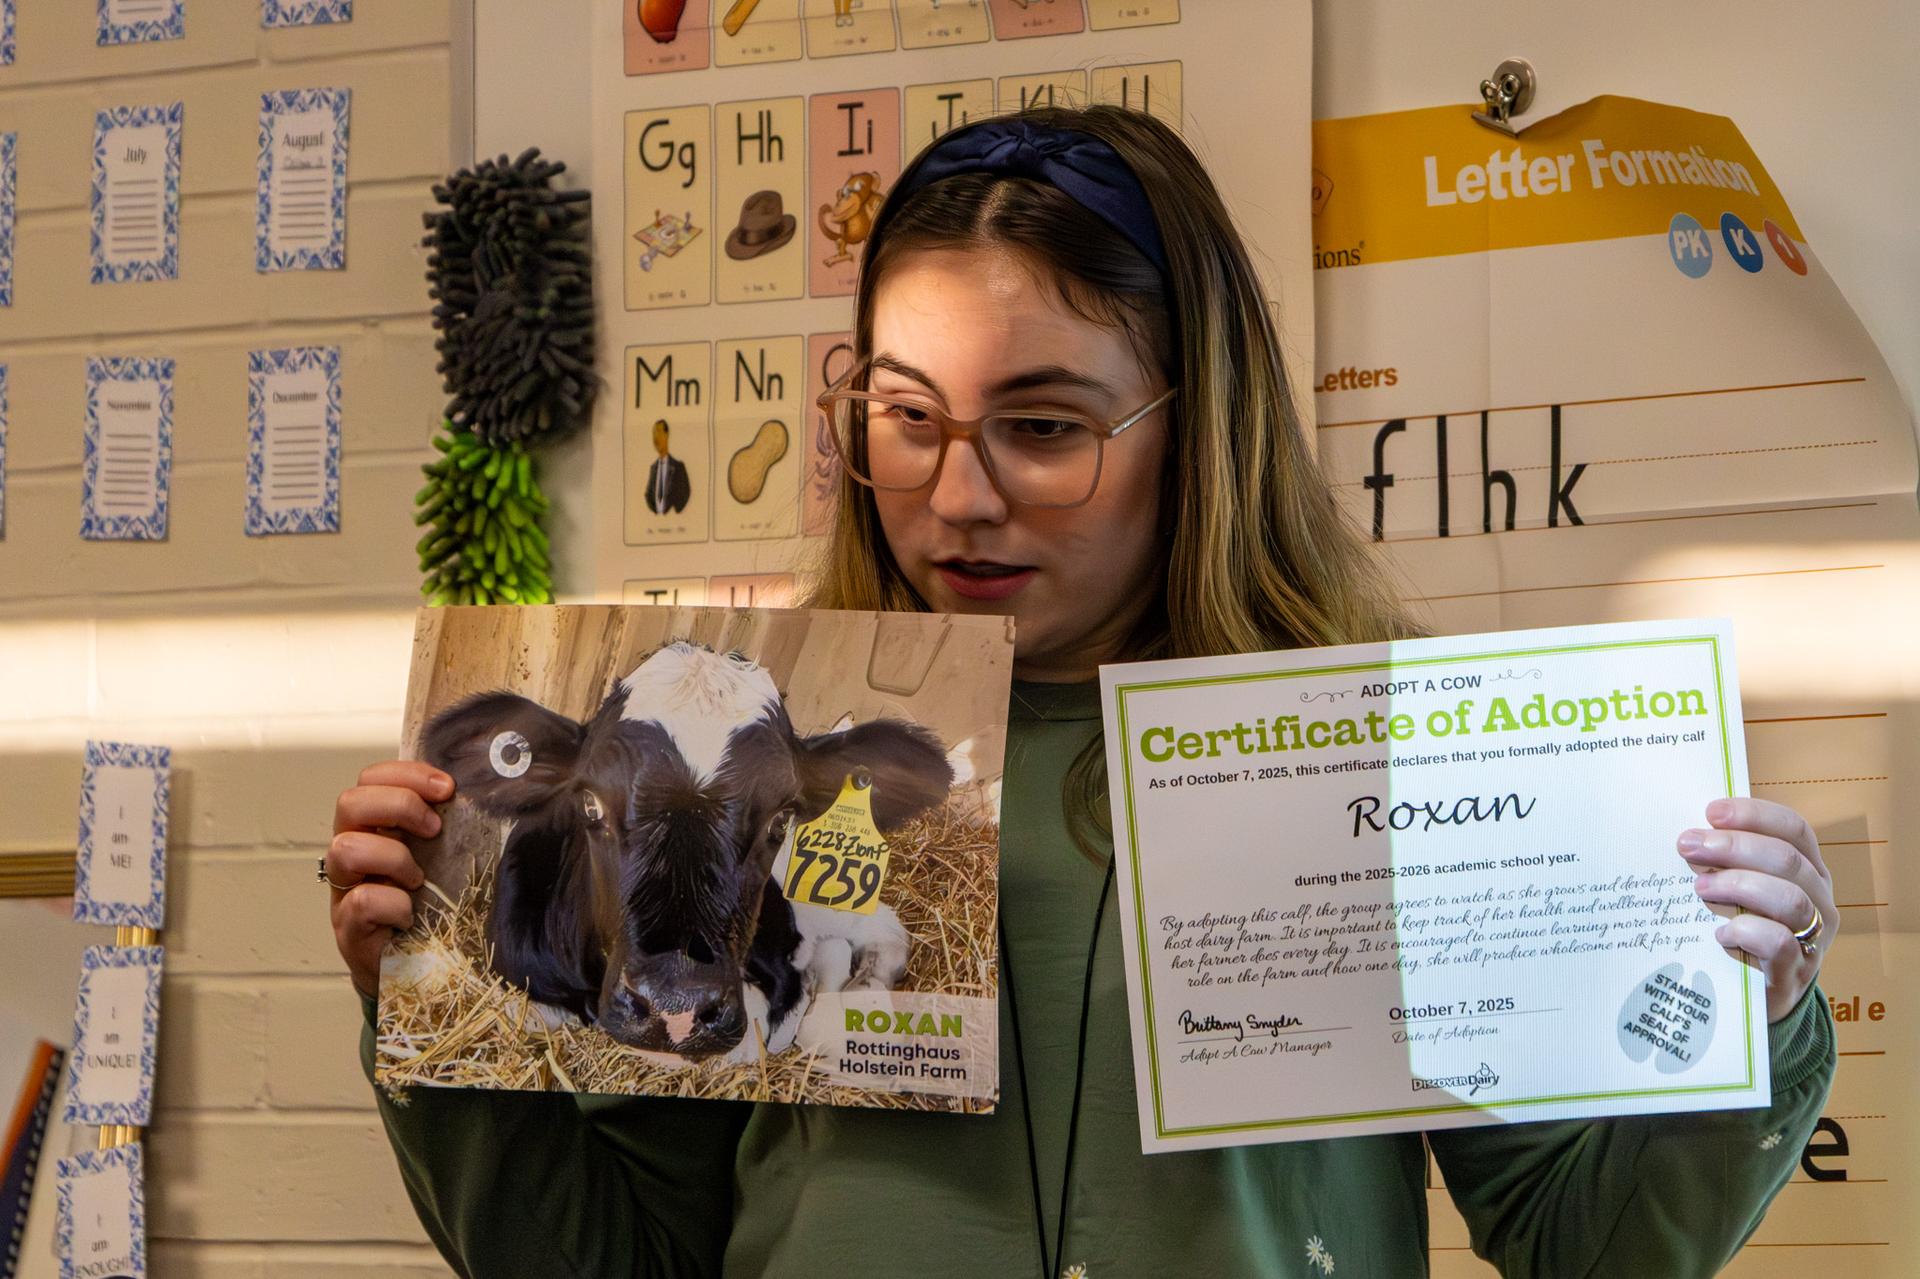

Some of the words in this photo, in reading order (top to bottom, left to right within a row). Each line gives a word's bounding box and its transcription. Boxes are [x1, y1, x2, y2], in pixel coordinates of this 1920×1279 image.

[282, 130, 323, 151] August
[736, 109, 785, 166] Hh
[836, 101, 874, 157] Ii
[123, 145, 147, 165] July
[639, 118, 697, 189] Gg
[1423, 148, 1573, 208] Letter
[1582, 139, 1760, 198] Formation
[1673, 228, 1709, 260] PK
[1729, 228, 1756, 256] K
[635, 354, 700, 409] Mm
[735, 348, 783, 403] Nn
[272, 391, 318, 404] December
[1363, 420, 1406, 543] f
[1481, 410, 1516, 533] h
[1548, 405, 1588, 528] k
[1360, 681, 1418, 698] ADOPT
[1425, 680, 1436, 692] A
[1441, 675, 1482, 691] COW
[1140, 711, 1415, 763] Certificate
[1426, 700, 1474, 737] of
[1482, 685, 1708, 733] Adoption
[1149, 778, 1167, 790] As
[1170, 775, 1183, 788] of
[1186, 770, 1239, 786] October
[1243, 770, 1255, 782] 7,
[1258, 766, 1293, 780] 2025,
[1295, 763, 1320, 777] this
[1324, 758, 1388, 775] certificate
[1392, 753, 1447, 768] declares
[1451, 750, 1477, 763] that
[1480, 749, 1505, 763] you
[1508, 742, 1562, 758] formally
[1565, 737, 1618, 753] adopted
[1622, 735, 1643, 747] the
[1646, 732, 1679, 746] dairy
[1682, 730, 1705, 742] calf
[1347, 792, 1536, 838] Roxan
[111, 832, 128, 845] am
[786, 848, 881, 910] 7259
[1295, 873, 1337, 887] during
[1341, 871, 1361, 883] the
[1365, 865, 1431, 881] 2025-2026
[1434, 857, 1497, 875] academic
[1500, 854, 1544, 868] school
[1548, 852, 1580, 867] year.
[1160, 915, 1184, 936] By
[1188, 912, 1248, 933] adopting
[1251, 908, 1277, 923] this
[1280, 904, 1312, 924] calf,
[1316, 902, 1338, 917] the
[1341, 904, 1382, 922] group
[1385, 897, 1431, 917] agrees
[1434, 896, 1447, 906] to
[1451, 887, 1493, 904] watch
[1497, 891, 1514, 901] as
[1518, 884, 1542, 900] she
[1544, 885, 1587, 903] grows
[1589, 877, 1621, 892] and
[1620, 873, 1676, 894] develops
[1164, 936, 1192, 951] host
[1196, 933, 1235, 952] dairy
[1237, 929, 1277, 950] farm.
[1280, 925, 1296, 940] It
[1299, 927, 1310, 939] is
[1314, 921, 1381, 942] important
[1385, 920, 1396, 930] to
[1402, 914, 1430, 934] keep
[1434, 910, 1471, 926] track
[1473, 909, 1489, 929] of
[1492, 907, 1515, 922] her
[1519, 902, 1564, 920] health
[1567, 897, 1599, 914] and
[1598, 893, 1663, 914] wellbeing
[1663, 893, 1693, 913] just
[1171, 956, 1196, 970] her
[1197, 953, 1248, 974] farmer
[1250, 949, 1281, 964] does
[1282, 946, 1321, 965] every
[1322, 941, 1353, 963] day.
[1356, 937, 1373, 953] It
[1375, 940, 1386, 952] is
[1390, 929, 1475, 952] encouraged
[1473, 931, 1485, 943] to
[1489, 925, 1547, 941] continue
[1550, 918, 1608, 938] learning
[1612, 918, 1647, 931] more
[1650, 911, 1690, 926] about
[1188, 974, 1213, 988] role
[1217, 975, 1233, 985] on
[1237, 968, 1259, 983] the
[1261, 966, 1298, 988] farm
[1301, 961, 1331, 978] and
[1332, 959, 1361, 975] how
[1365, 962, 1388, 971] one
[1392, 955, 1422, 975] day,
[1427, 952, 1450, 967] she
[1453, 949, 1482, 964] will
[1481, 946, 1537, 968] produce
[1540, 939, 1613, 956] wholesome
[1617, 933, 1649, 948] milk
[1650, 932, 1670, 952] for
[1675, 935, 1704, 951] you.
[1389, 1003, 1452, 1021] October
[1458, 1001, 1473, 1016] 7,
[1477, 997, 1515, 1013] 2025
[1645, 983, 1675, 1006] WITH
[1677, 1000, 1710, 1024] YOUR
[1655, 973, 1711, 1009] STAMPED
[845, 1008, 963, 1038] ROXAN
[1246, 1013, 1303, 1037] Snyder
[1639, 1013, 1668, 1036] SEAL
[1673, 1030, 1690, 1044] OF
[1650, 1003, 1691, 1030] CALF'S
[1868, 1002, 1886, 1021] e
[846, 1040, 961, 1062] Rottinghaus
[1180, 1048, 1220, 1065] Adopt
[1223, 1045, 1238, 1058] A
[1240, 1043, 1268, 1057] Cow
[1270, 1039, 1333, 1056] Manager
[1391, 1029, 1426, 1044] Date
[1428, 1026, 1442, 1045] of
[1443, 1024, 1500, 1042] Adoption
[1624, 1022, 1692, 1063] APPROVAL!
[839, 1059, 916, 1077] Holstein
[920, 1062, 967, 1080] Farm
[1801, 1117, 1849, 1182] e
